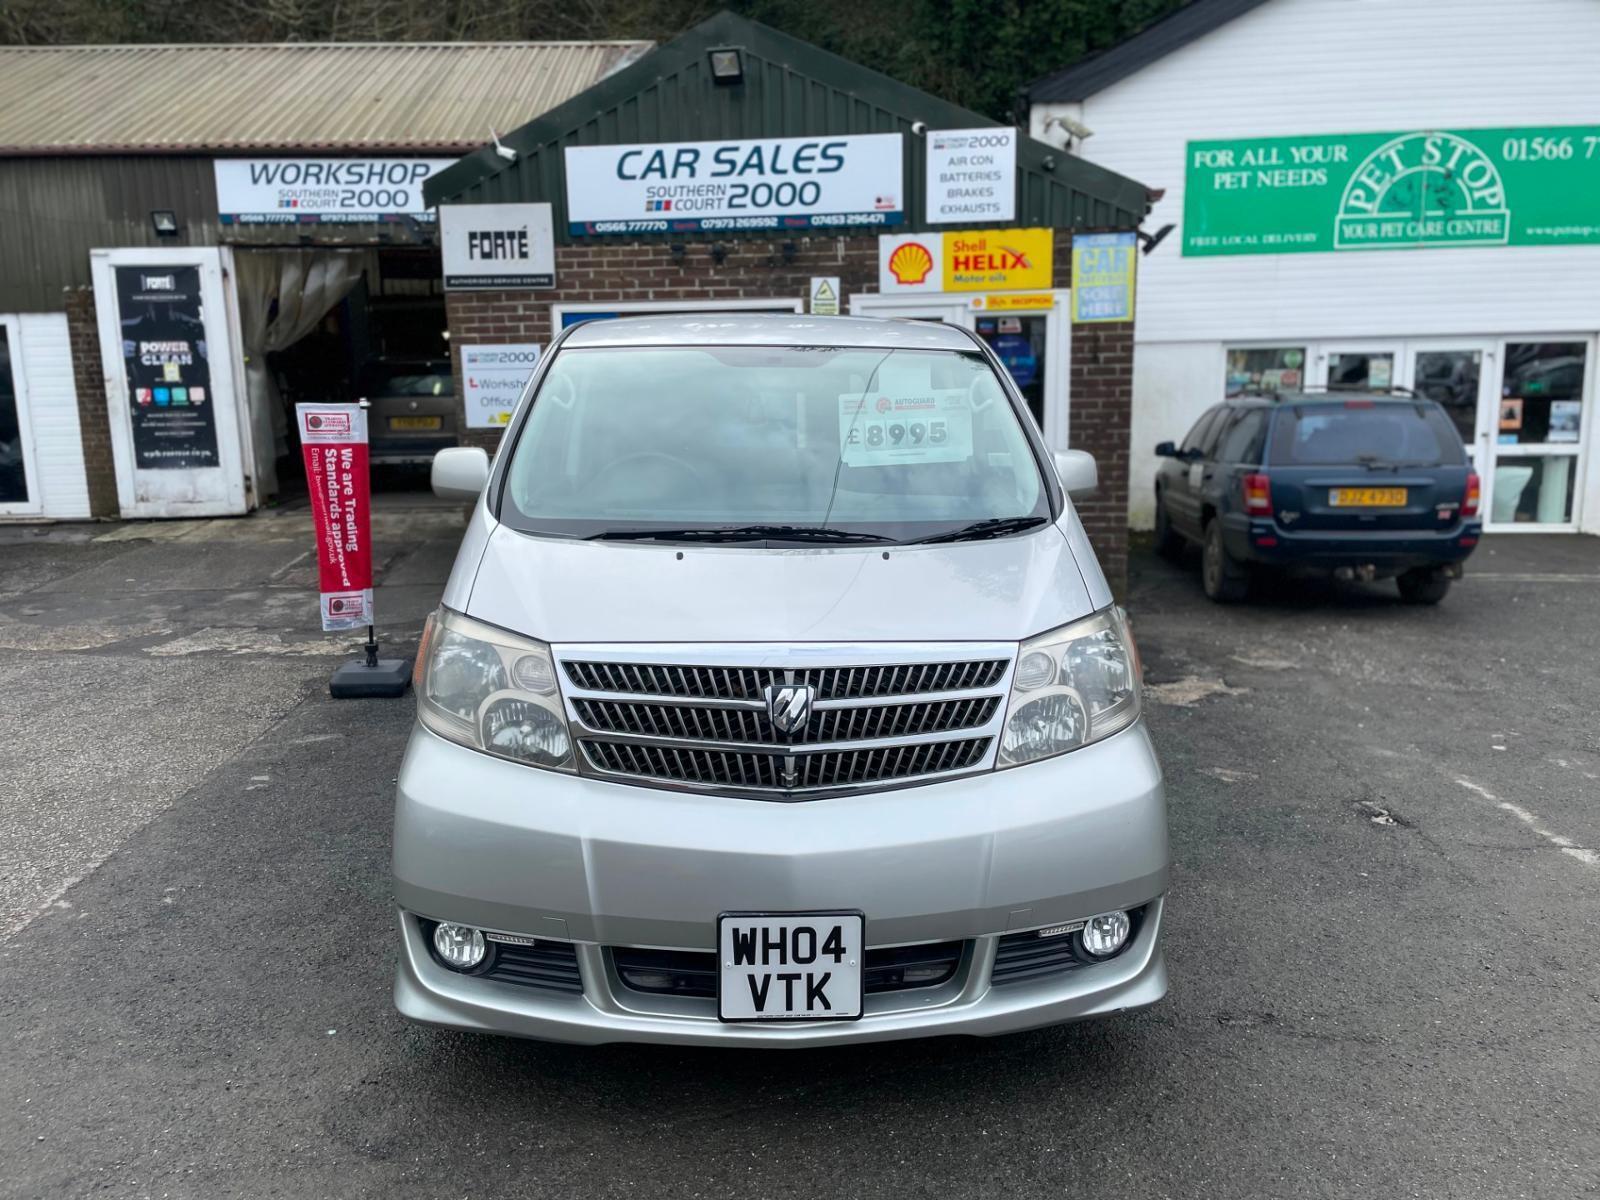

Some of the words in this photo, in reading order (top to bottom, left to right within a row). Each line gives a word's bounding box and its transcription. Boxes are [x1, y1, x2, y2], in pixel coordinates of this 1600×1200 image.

[968, 135, 1010, 148] 2000
[1502, 137, 1574, 161] 01566
[615, 148, 701, 180] CAR
[710, 142, 848, 177] SALES
[948, 156, 968, 166] AIR
[970, 155, 994, 165] CON
[1194, 149, 1235, 168] FOR
[1240, 147, 1284, 166] ALL
[1290, 145, 1349, 164] YOUR
[250, 163, 431, 185] WORKSHOP
[940, 170, 1002, 183] BATTERIES
[1214, 171, 1252, 189] PET
[1257, 168, 1328, 187] NEEDS
[1348, 143, 1406, 211] PET
[1421, 136, 1501, 206] STOP
[278, 189, 339, 198] SOUTHERN
[340, 189, 409, 208] 2000
[646, 184, 727, 198] SOUTHERN
[727, 181, 821, 209] 2000
[947, 187, 994, 198] BRAKES
[300, 199, 337, 208] COURT
[674, 198, 724, 211] COURT
[940, 203, 1001, 214] EXHAUSTS
[595, 221, 627, 232] 01566
[701, 219, 734, 230] 07973
[1342, 222, 1379, 238] YOUR
[1381, 222, 1404, 237] PET
[1406, 221, 1444, 237] CARE
[1447, 219, 1502, 235] CENTRE
[468, 225, 529, 260] FORTÉ
[953, 239, 986, 253] Shell
[1190, 236, 1218, 246] FREE
[1222, 234, 1258, 245] LOCAL
[1263, 233, 1317, 244] DELIVERY
[953, 252, 1029, 271] HELIX
[1080, 248, 1127, 273] CAR
[953, 275, 985, 283] Motor
[140, 341, 190, 354] POWER
[141, 354, 193, 366] CLEAN
[499, 352, 536, 363] 2000
[480, 397, 513, 407] Office
[311, 447, 322, 474] Email:
[340, 448, 353, 470] We
[324, 448, 342, 519] Standards
[342, 473, 353, 495] are
[345, 498, 358, 552] Trading
[331, 522, 351, 587] approved
[732, 926, 846, 965] WH04
[747, 972, 832, 1012] VTK
